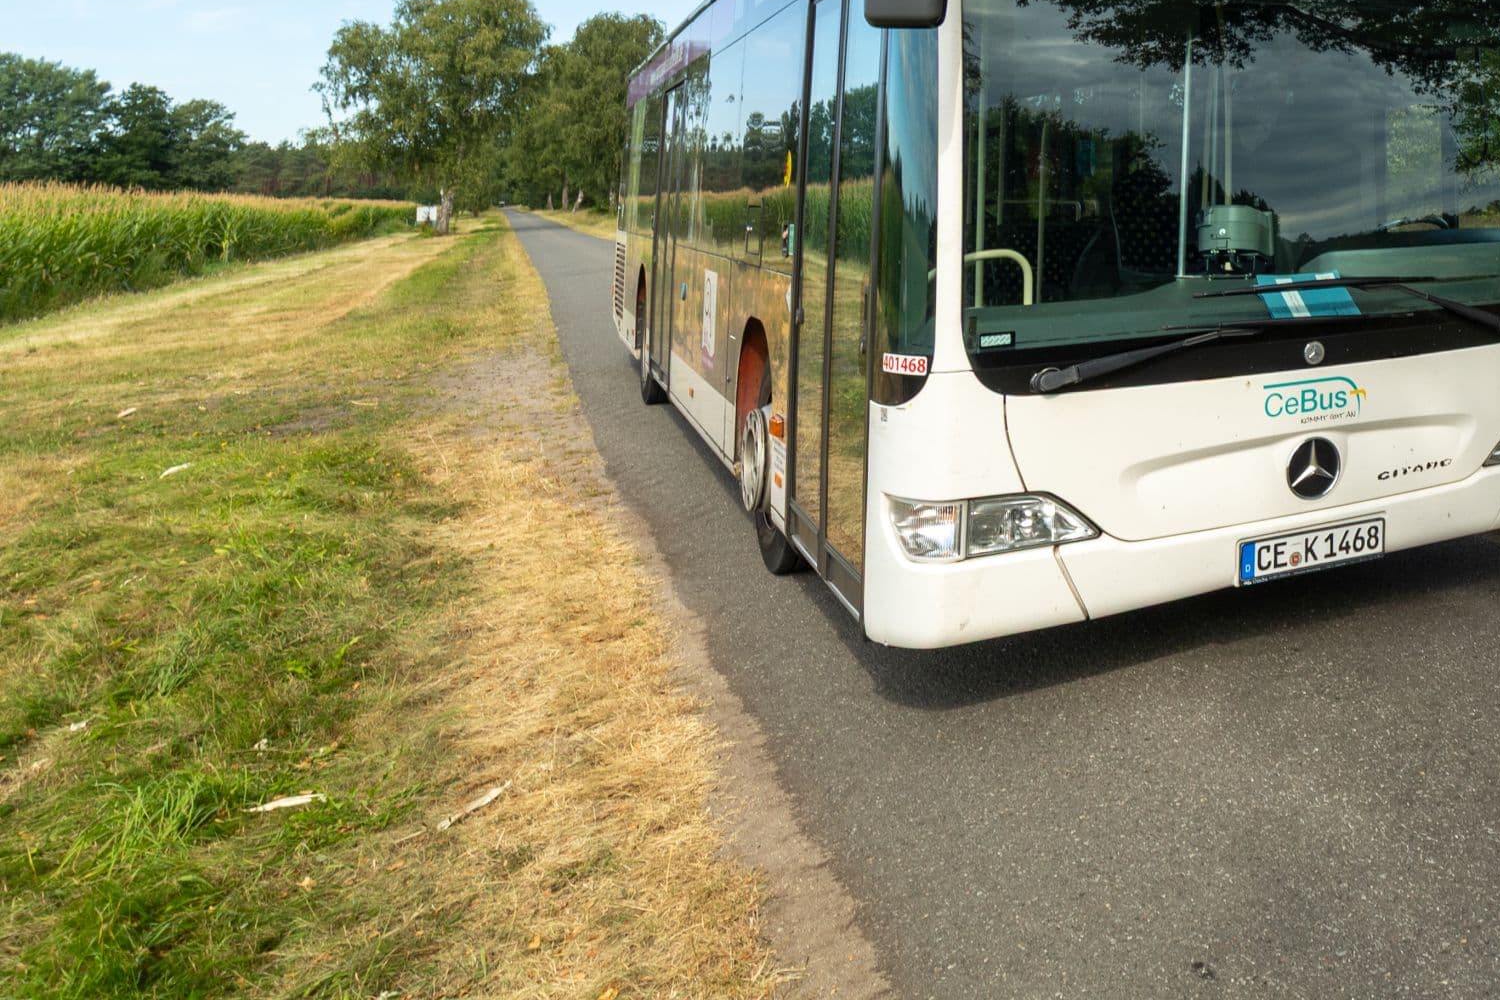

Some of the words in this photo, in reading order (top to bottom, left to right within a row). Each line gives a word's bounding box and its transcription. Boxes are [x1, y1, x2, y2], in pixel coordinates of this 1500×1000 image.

[883, 355, 926, 373] 401468
[1264, 388, 1348, 418] CeBus
[1257, 541, 1288, 571] CE
[1245, 564, 1251, 573] D
